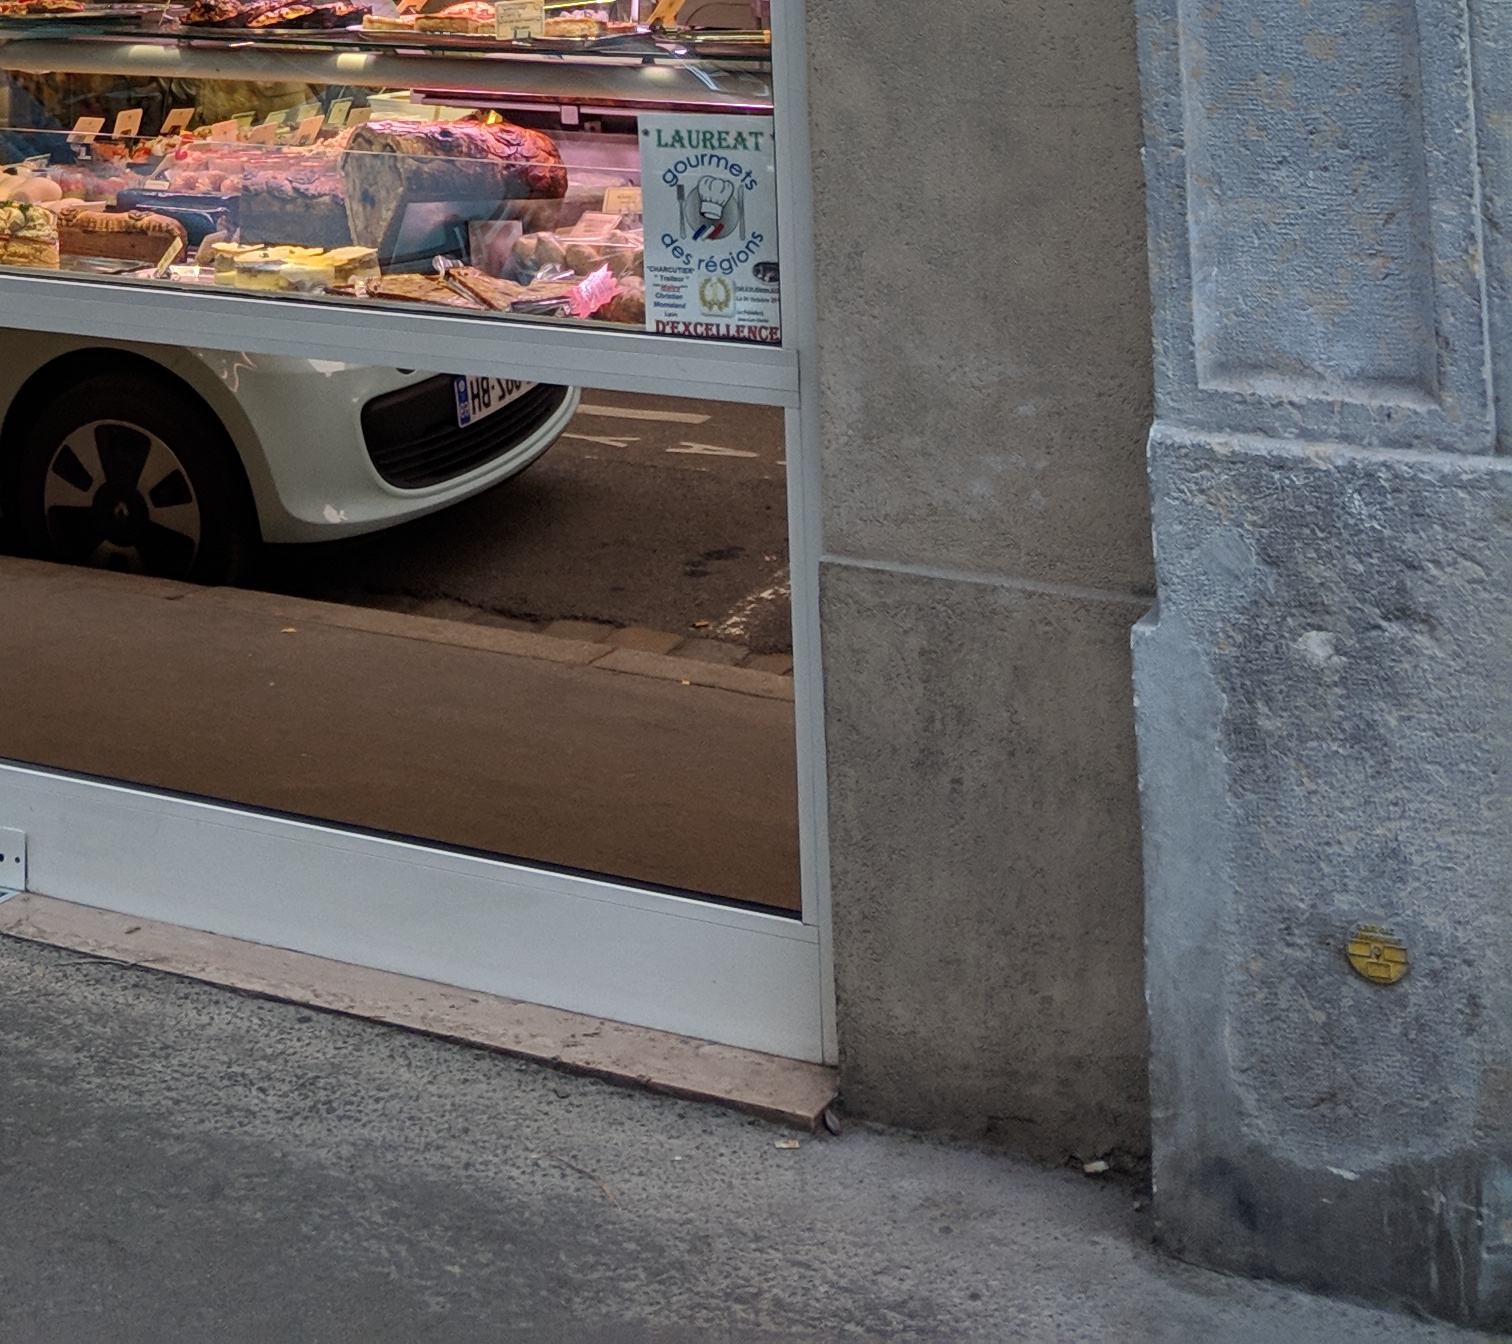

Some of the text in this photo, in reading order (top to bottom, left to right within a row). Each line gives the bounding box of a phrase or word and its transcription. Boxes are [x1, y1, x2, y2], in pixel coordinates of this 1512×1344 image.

[656, 128, 764, 152] LAUREAT
[661, 153, 758, 191] gourmets
[661, 230, 764, 275] des régions
[655, 319, 780, 342] D'EXCELLENCE
